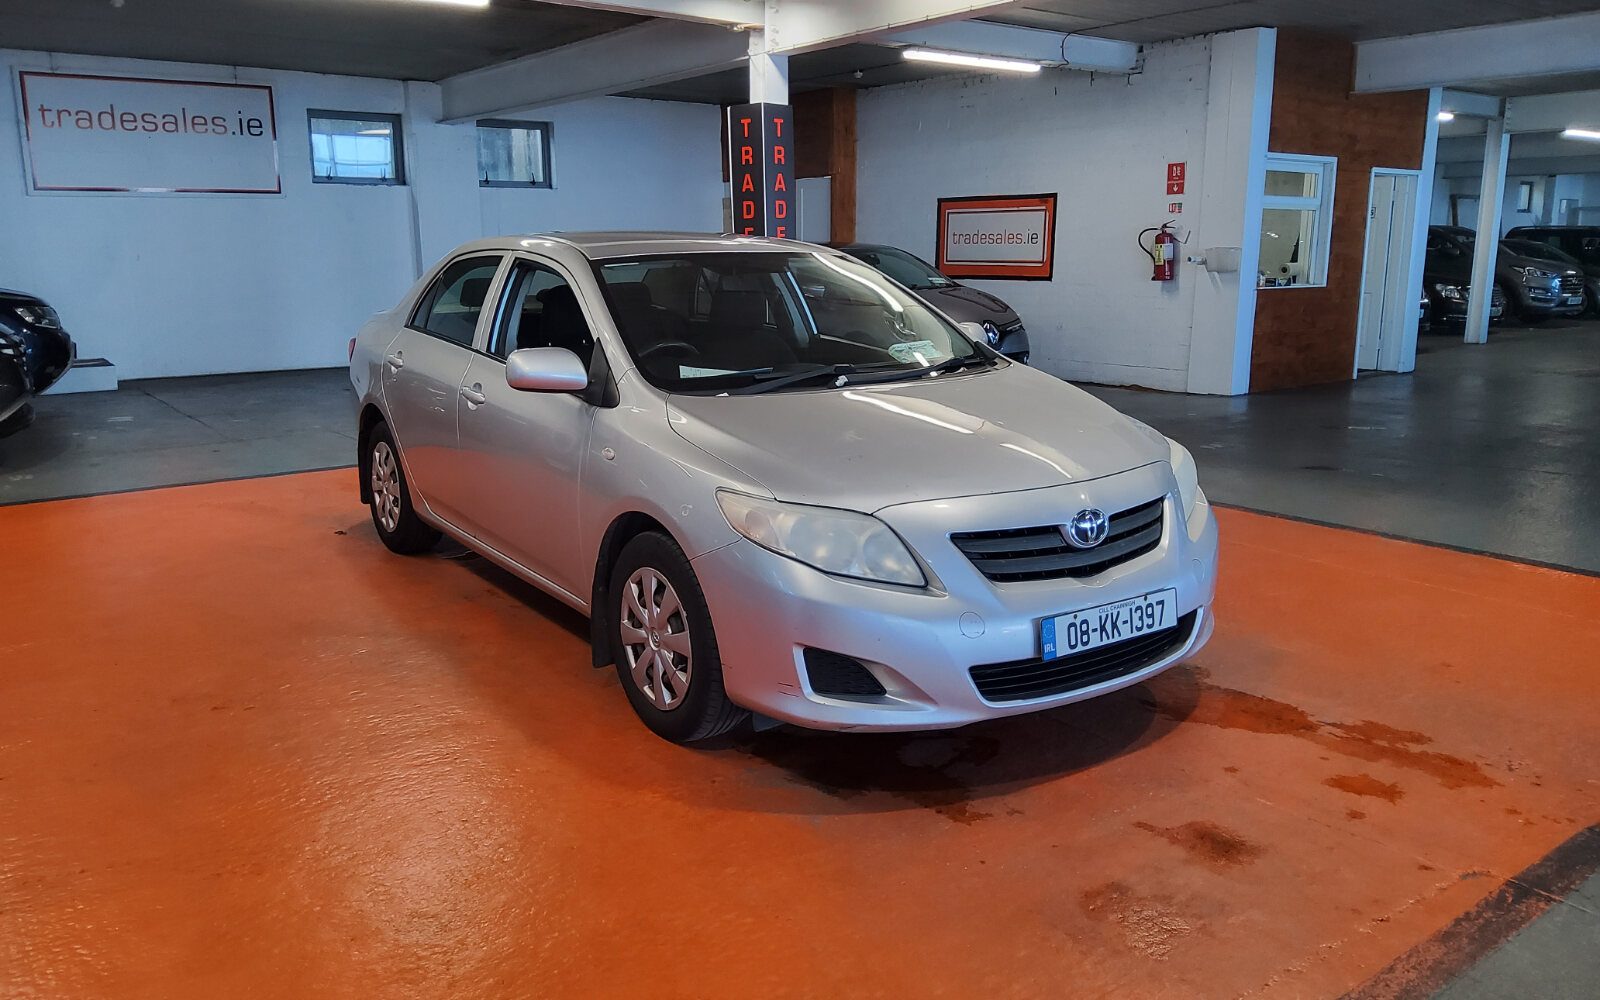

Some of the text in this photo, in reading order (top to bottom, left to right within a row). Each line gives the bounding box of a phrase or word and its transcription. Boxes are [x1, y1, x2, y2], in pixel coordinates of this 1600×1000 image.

[38, 103, 264, 137] tradesales.ie
[952, 228, 1039, 245] tradesales.ie
[1067, 599, 1165, 650] 08-KK-1397
[1044, 642, 1056, 653] IRL
